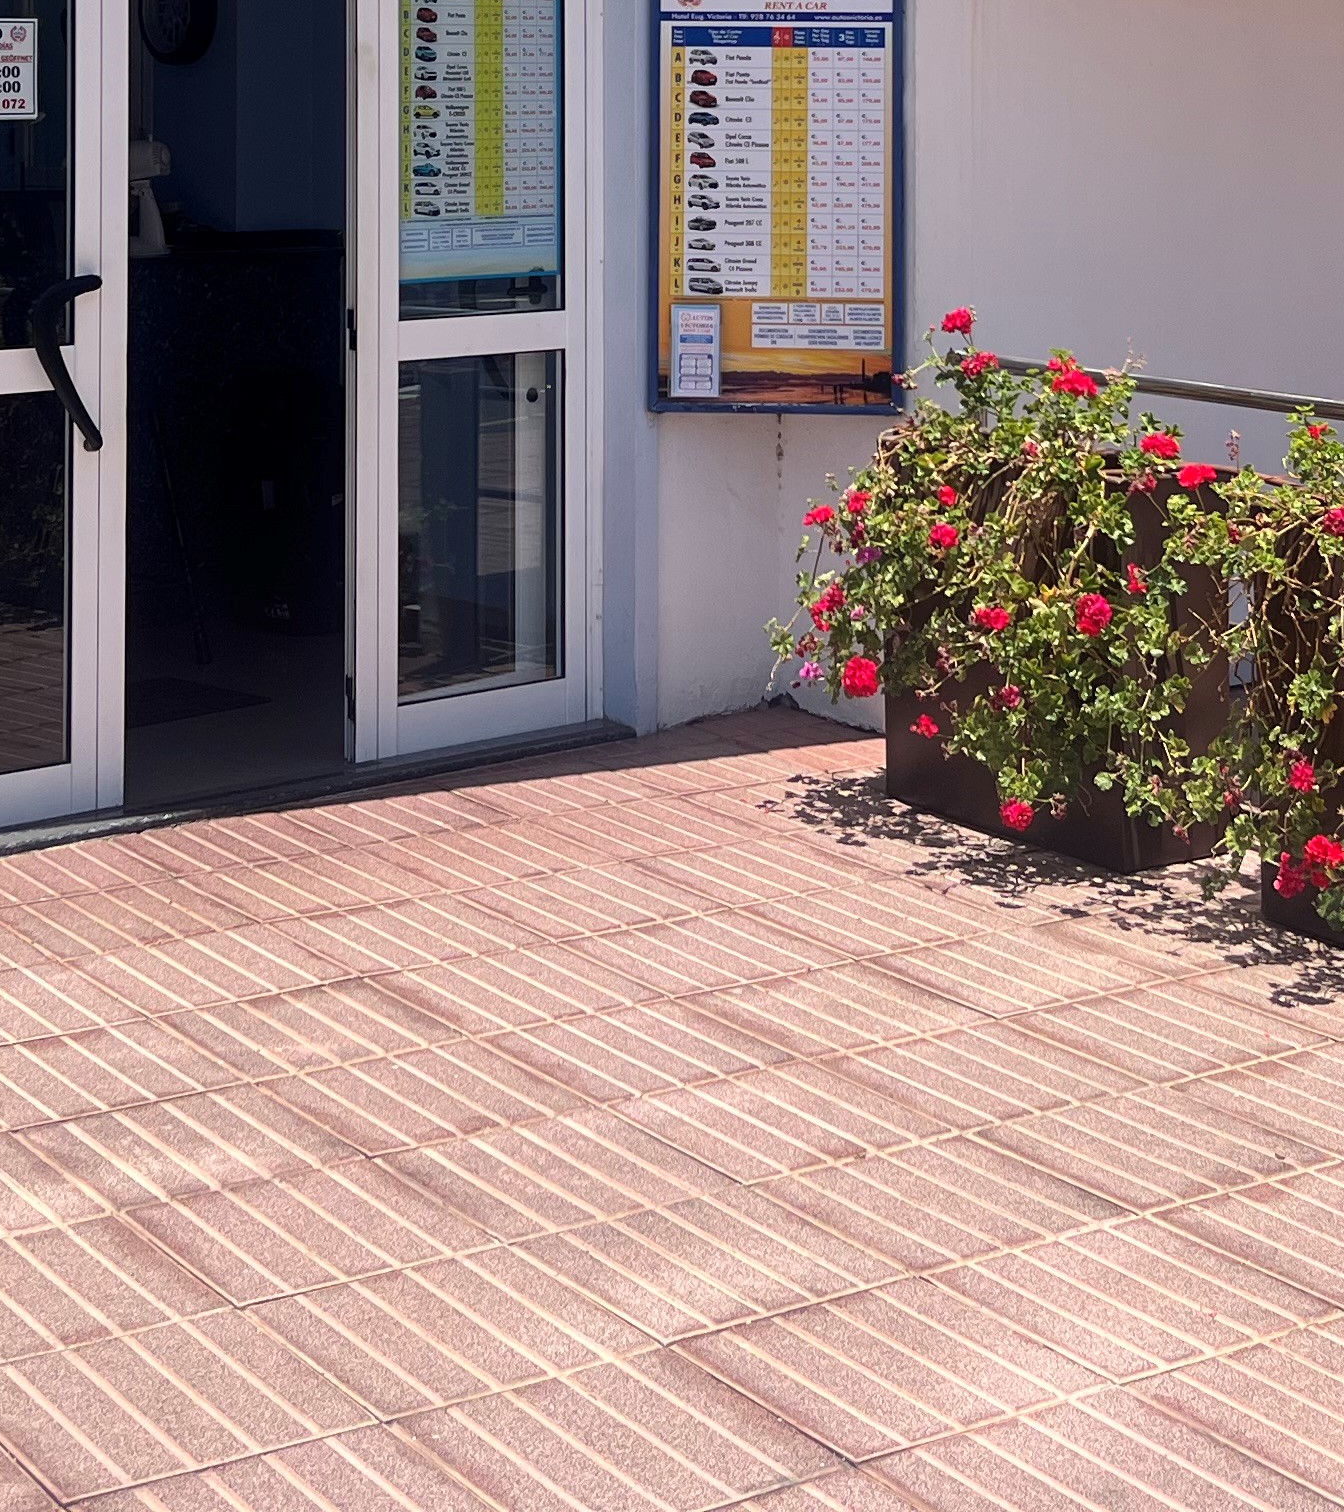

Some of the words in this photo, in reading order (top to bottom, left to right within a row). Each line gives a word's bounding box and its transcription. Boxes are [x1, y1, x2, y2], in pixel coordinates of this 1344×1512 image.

[764, 1, 794, 10] RENT
[795, 2, 803, 10] A
[805, 1, 828, 10] CAR
[839, 33, 845, 41] 3
[675, 53, 681, 62] A
[675, 73, 681, 82] B
[675, 93, 681, 102] C
[2, 98, 26, 110] 072
[675, 113, 681, 122] D
[675, 133, 681, 142] E
[675, 154, 681, 163] F
[674, 175, 681, 184] G
[674, 195, 681, 205] H
[674, 257, 680, 267] K
[674, 278, 679, 288] L
